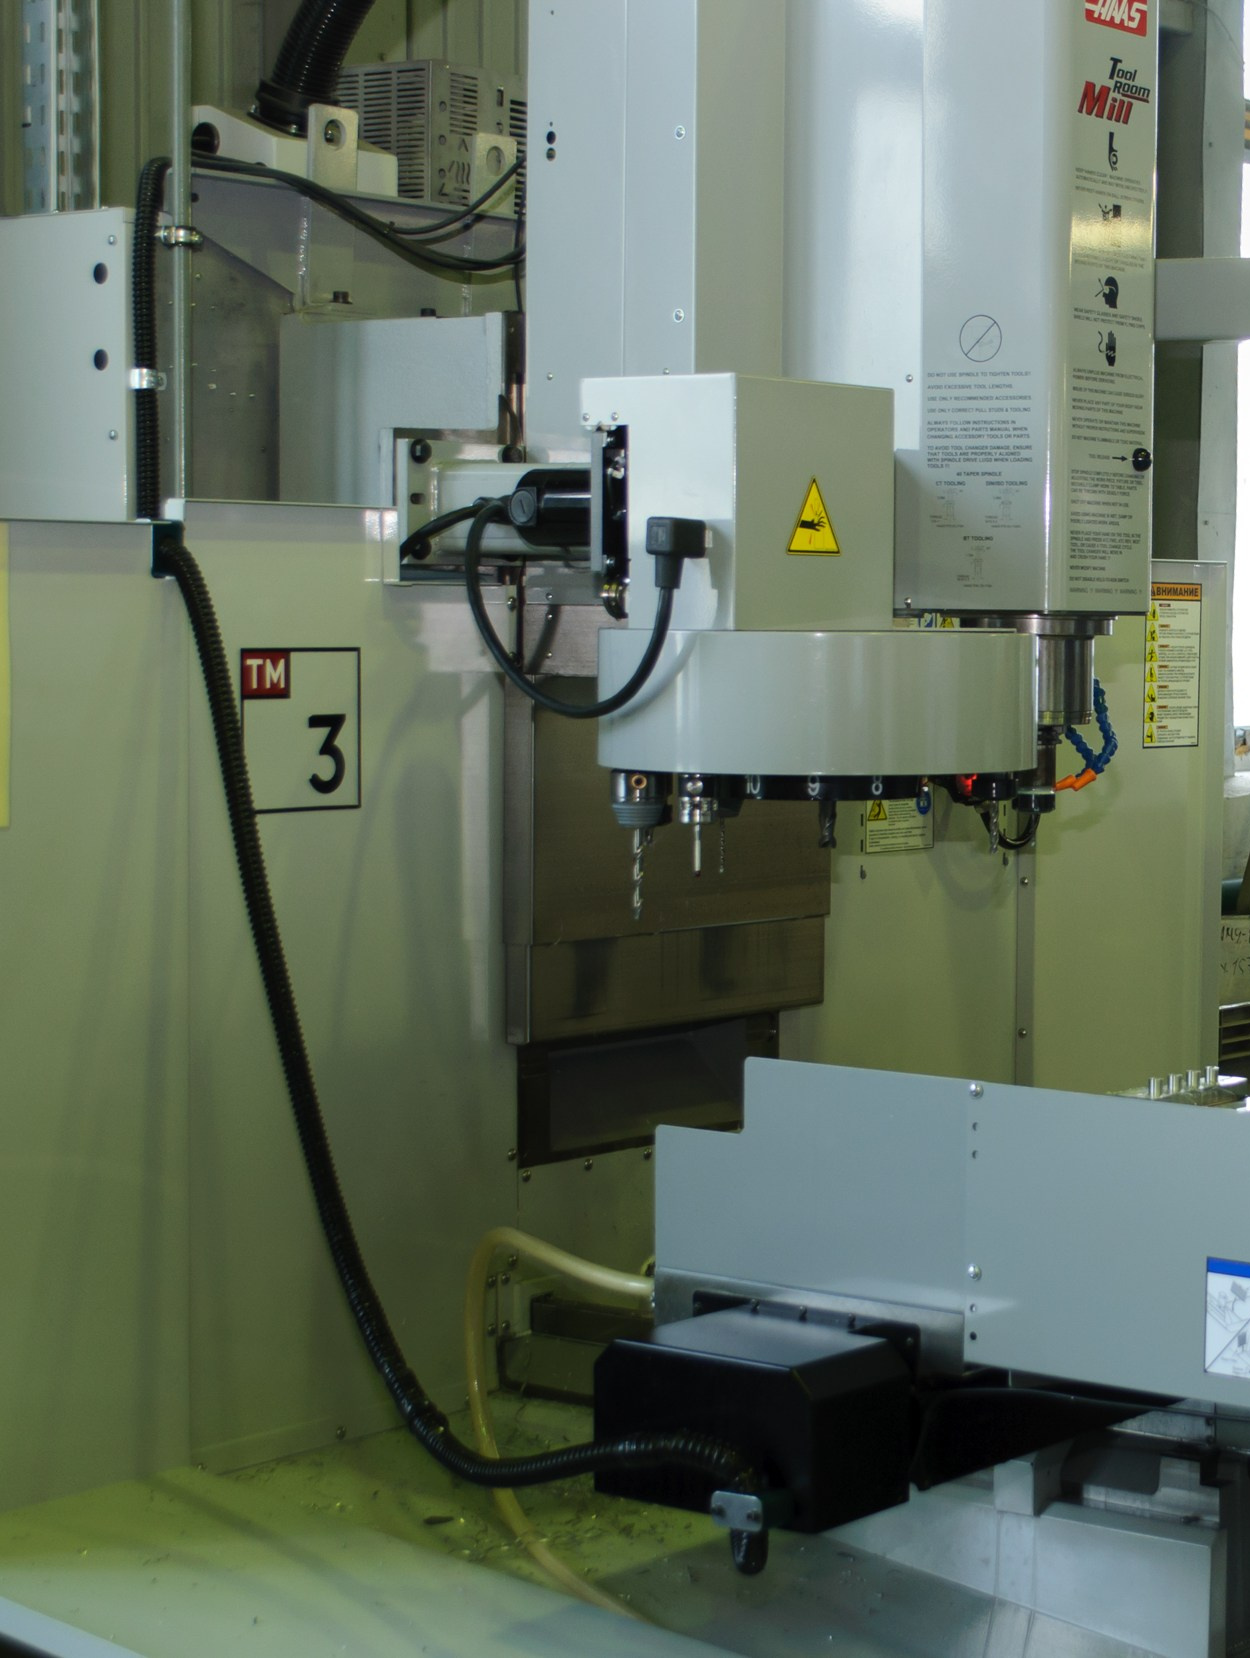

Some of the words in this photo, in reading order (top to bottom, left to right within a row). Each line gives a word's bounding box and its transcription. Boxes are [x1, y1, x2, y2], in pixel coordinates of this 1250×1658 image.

[1085, 0, 1147, 29] HAAS
[1108, 57, 1138, 82] Tool
[1077, 80, 1134, 125] Mill
[1156, 585, 1200, 598] ВНИМАНИЕ
[246, 658, 286, 690] TM
[308, 713, 346, 795] 3
